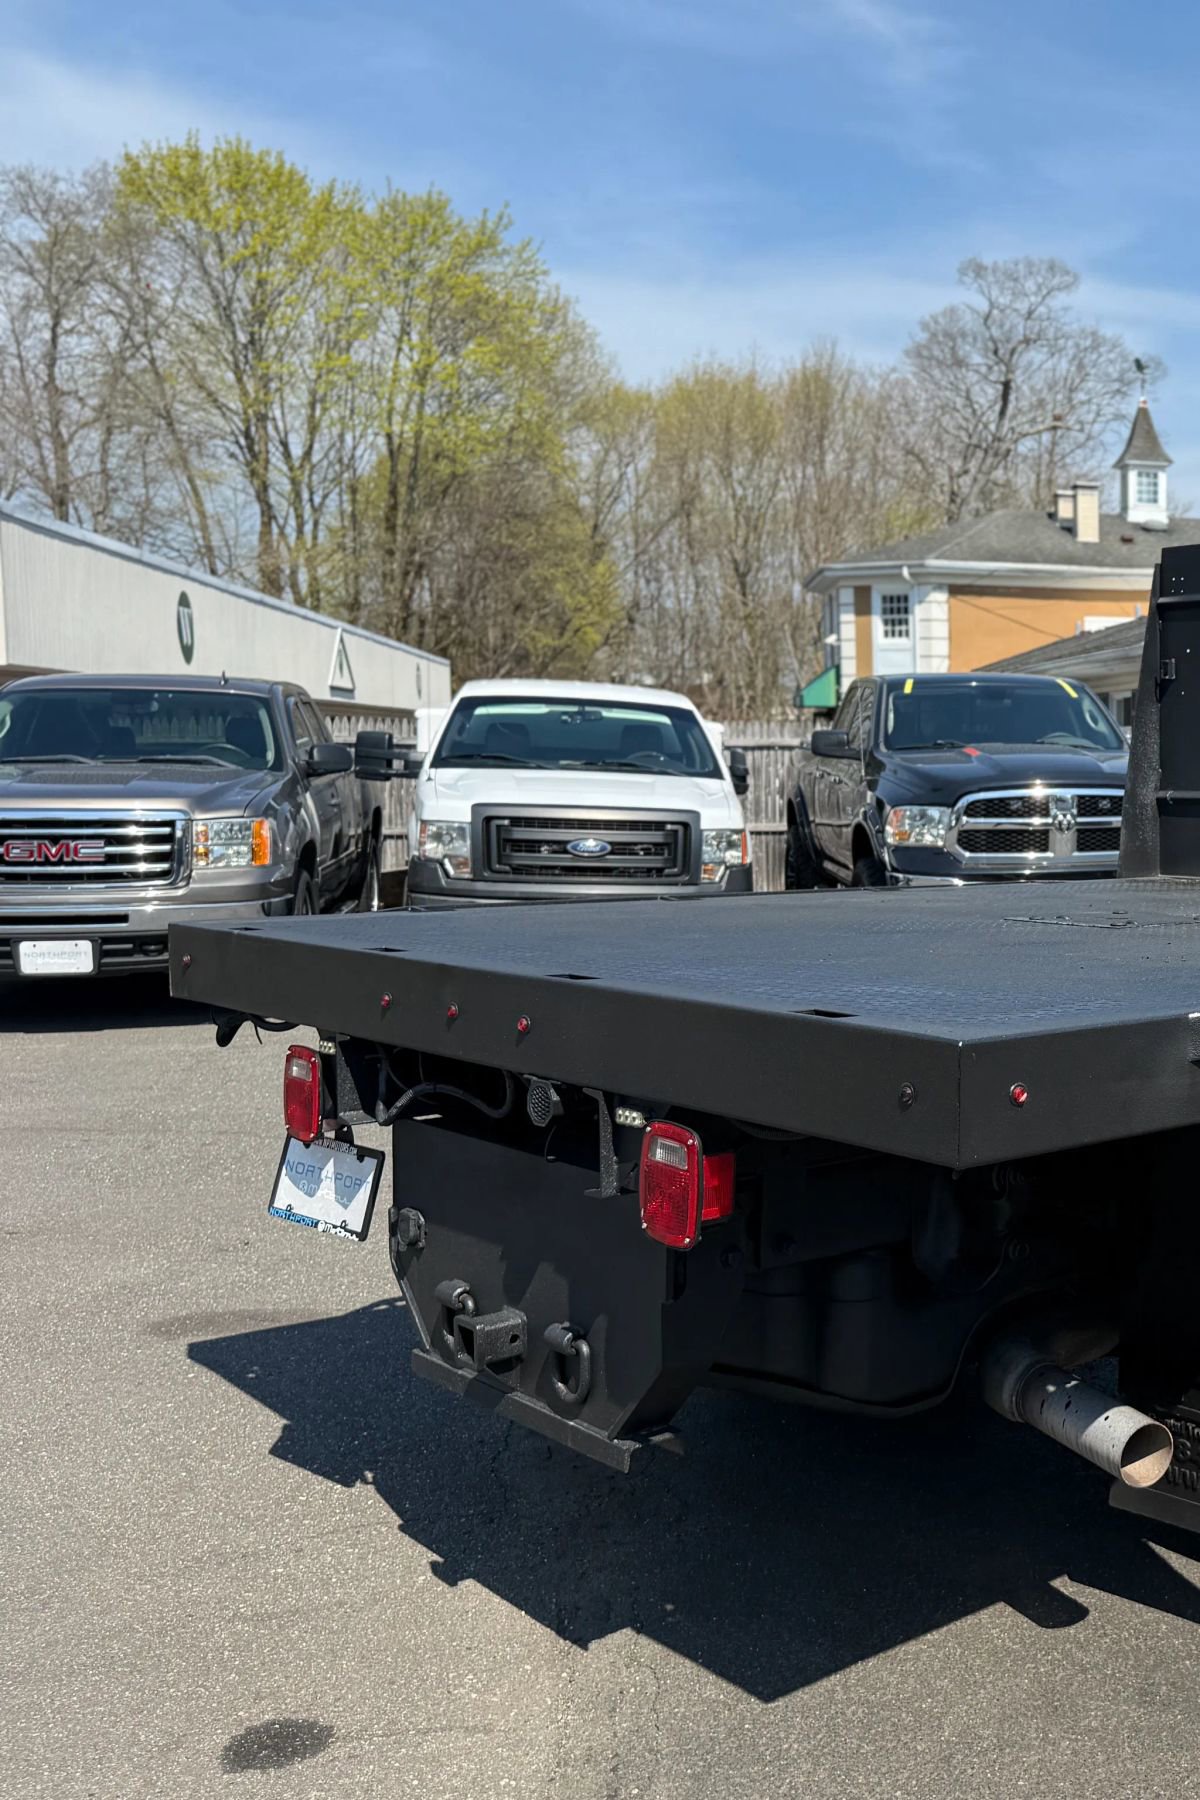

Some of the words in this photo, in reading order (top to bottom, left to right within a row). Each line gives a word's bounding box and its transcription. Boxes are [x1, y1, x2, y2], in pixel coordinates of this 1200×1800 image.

[3, 839, 105, 862] GMC
[284, 1159, 370, 1193] NORTHPORT
[269, 1207, 318, 1228] NORTHPORT
